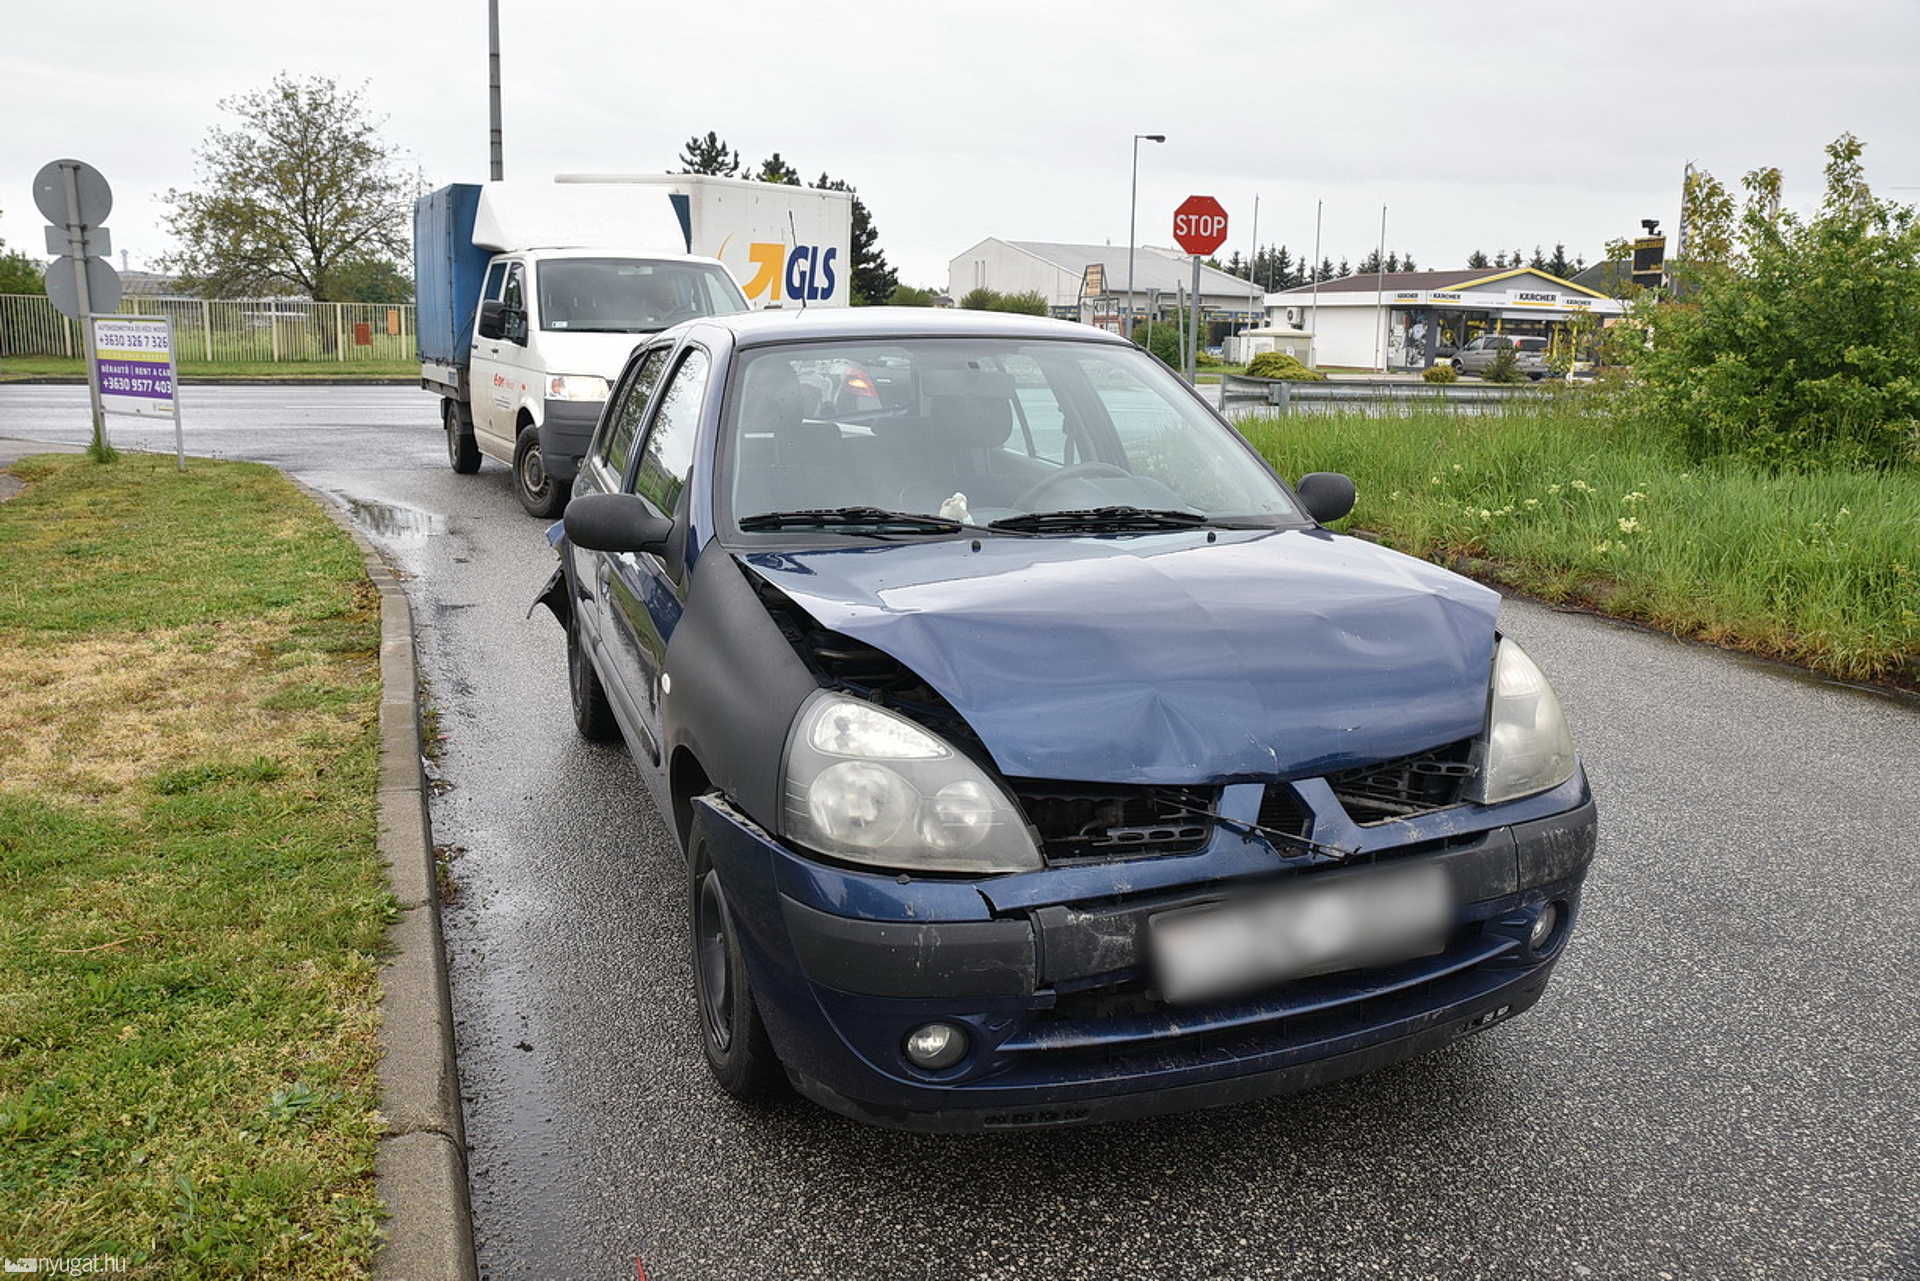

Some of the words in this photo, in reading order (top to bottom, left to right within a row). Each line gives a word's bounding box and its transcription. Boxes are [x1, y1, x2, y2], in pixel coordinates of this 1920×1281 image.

[1176, 214, 1226, 238] STOP
[785, 245, 837, 300] GLS
[100, 334, 125, 346] +3630
[126, 334, 143, 347] 326
[144, 335, 150, 347] 7
[152, 336, 168, 348] 326
[134, 366, 151, 375] RENT
[153, 368, 158, 376] A
[103, 377, 131, 391] +3630
[131, 378, 153, 392] 9577
[154, 380, 172, 394] 403
